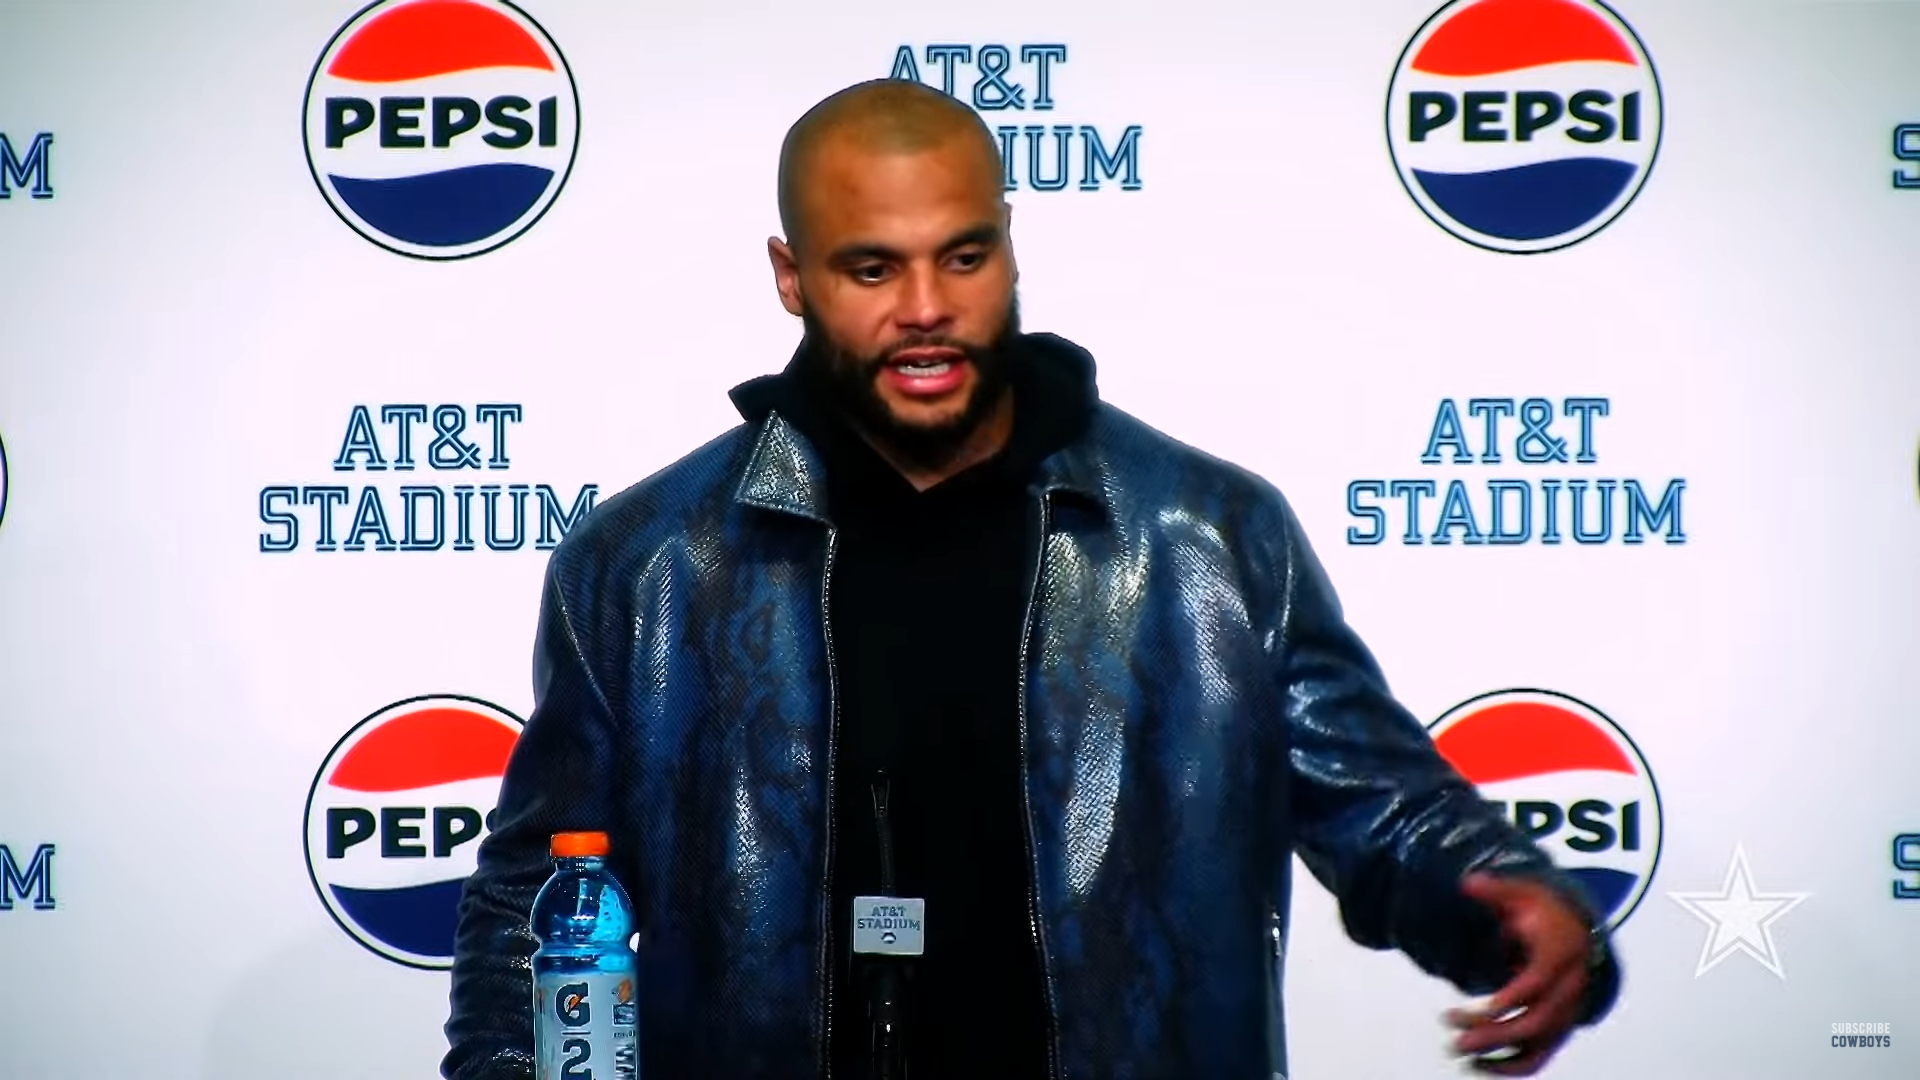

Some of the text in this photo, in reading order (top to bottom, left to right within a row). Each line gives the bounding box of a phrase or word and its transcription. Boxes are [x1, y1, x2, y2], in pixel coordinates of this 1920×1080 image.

[325, 96, 557, 149] PEPSI
[1408, 90, 1641, 142] PEPSI
[333, 404, 522, 470] AT&T
[1421, 398, 1608, 464] AT&T
[259, 484, 598, 552] STADIUM
[1347, 479, 1686, 545] STADIUM
[326, 806, 497, 859] PEP
[1486, 799, 1641, 853] PSI
[857, 918, 920, 930] STADIUM
[871, 906, 905, 917] AT&T
